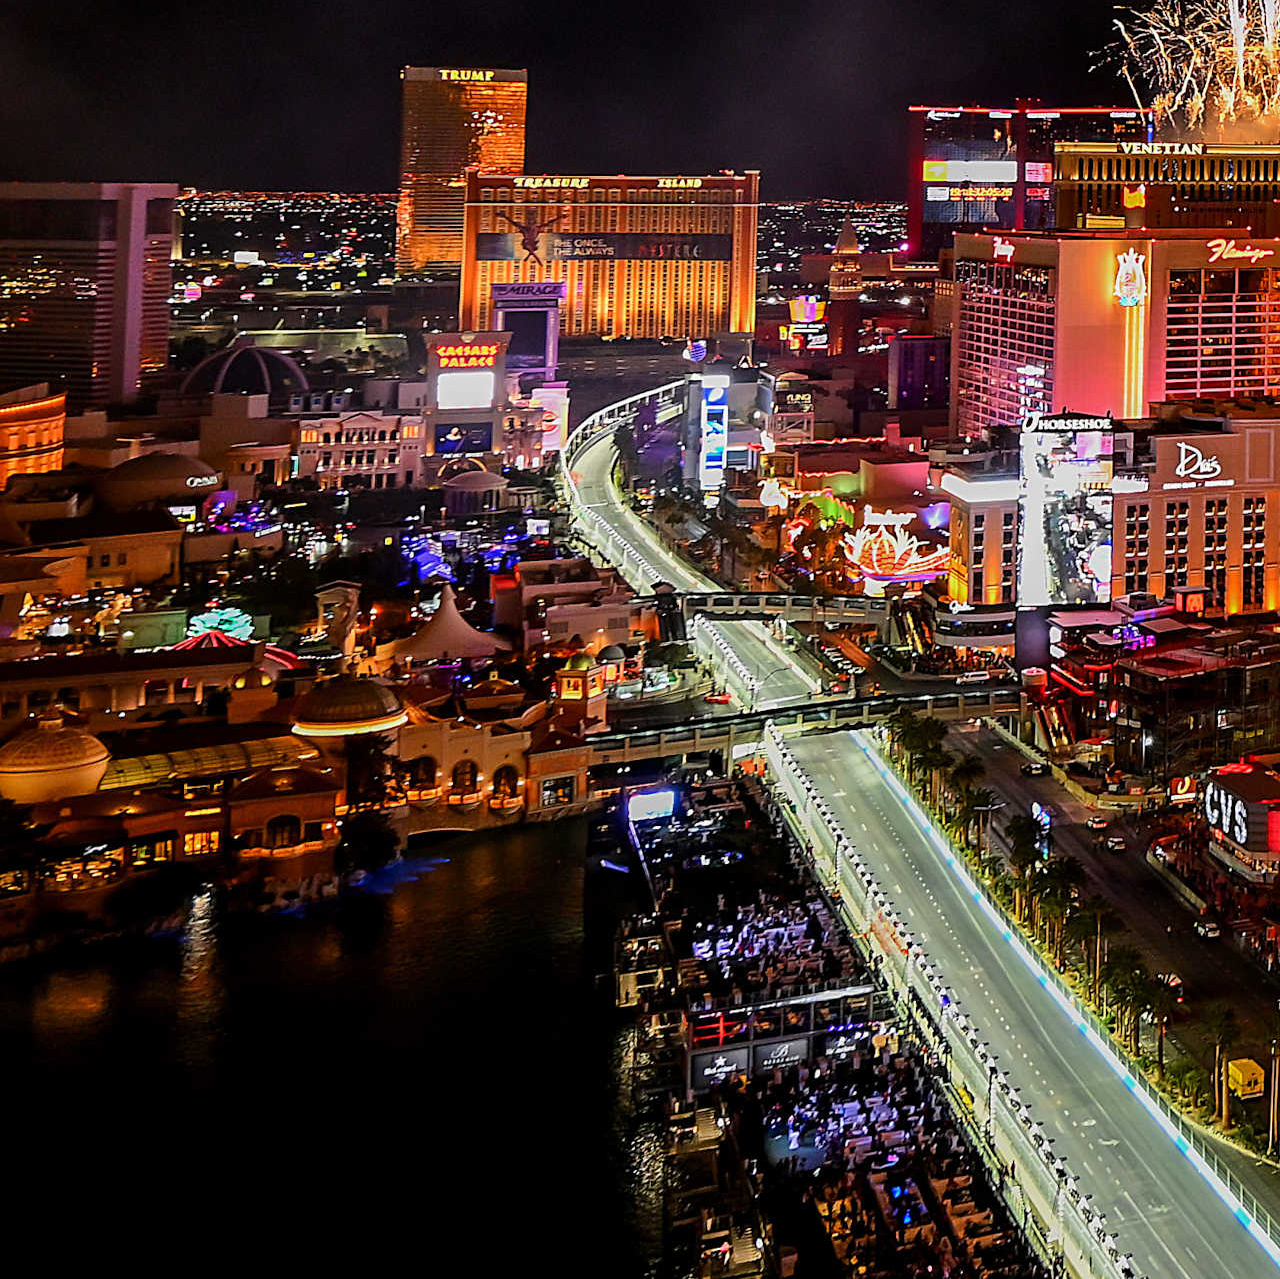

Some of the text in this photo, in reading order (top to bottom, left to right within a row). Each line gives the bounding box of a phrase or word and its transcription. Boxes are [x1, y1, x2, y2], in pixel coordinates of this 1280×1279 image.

[439, 69, 495, 81] TRUMP
[1120, 142, 1204, 155] VENETIAN
[513, 177, 702, 188] TREASURE ISLAND
[574, 247, 615, 256] ALWAYS
[1206, 239, 1274, 263] Flamingo
[437, 345, 498, 356] CAESARS
[439, 356, 496, 368] PALACE
[1038, 416, 1113, 431] HORSESHOE
[1205, 781, 1248, 845] CVS
